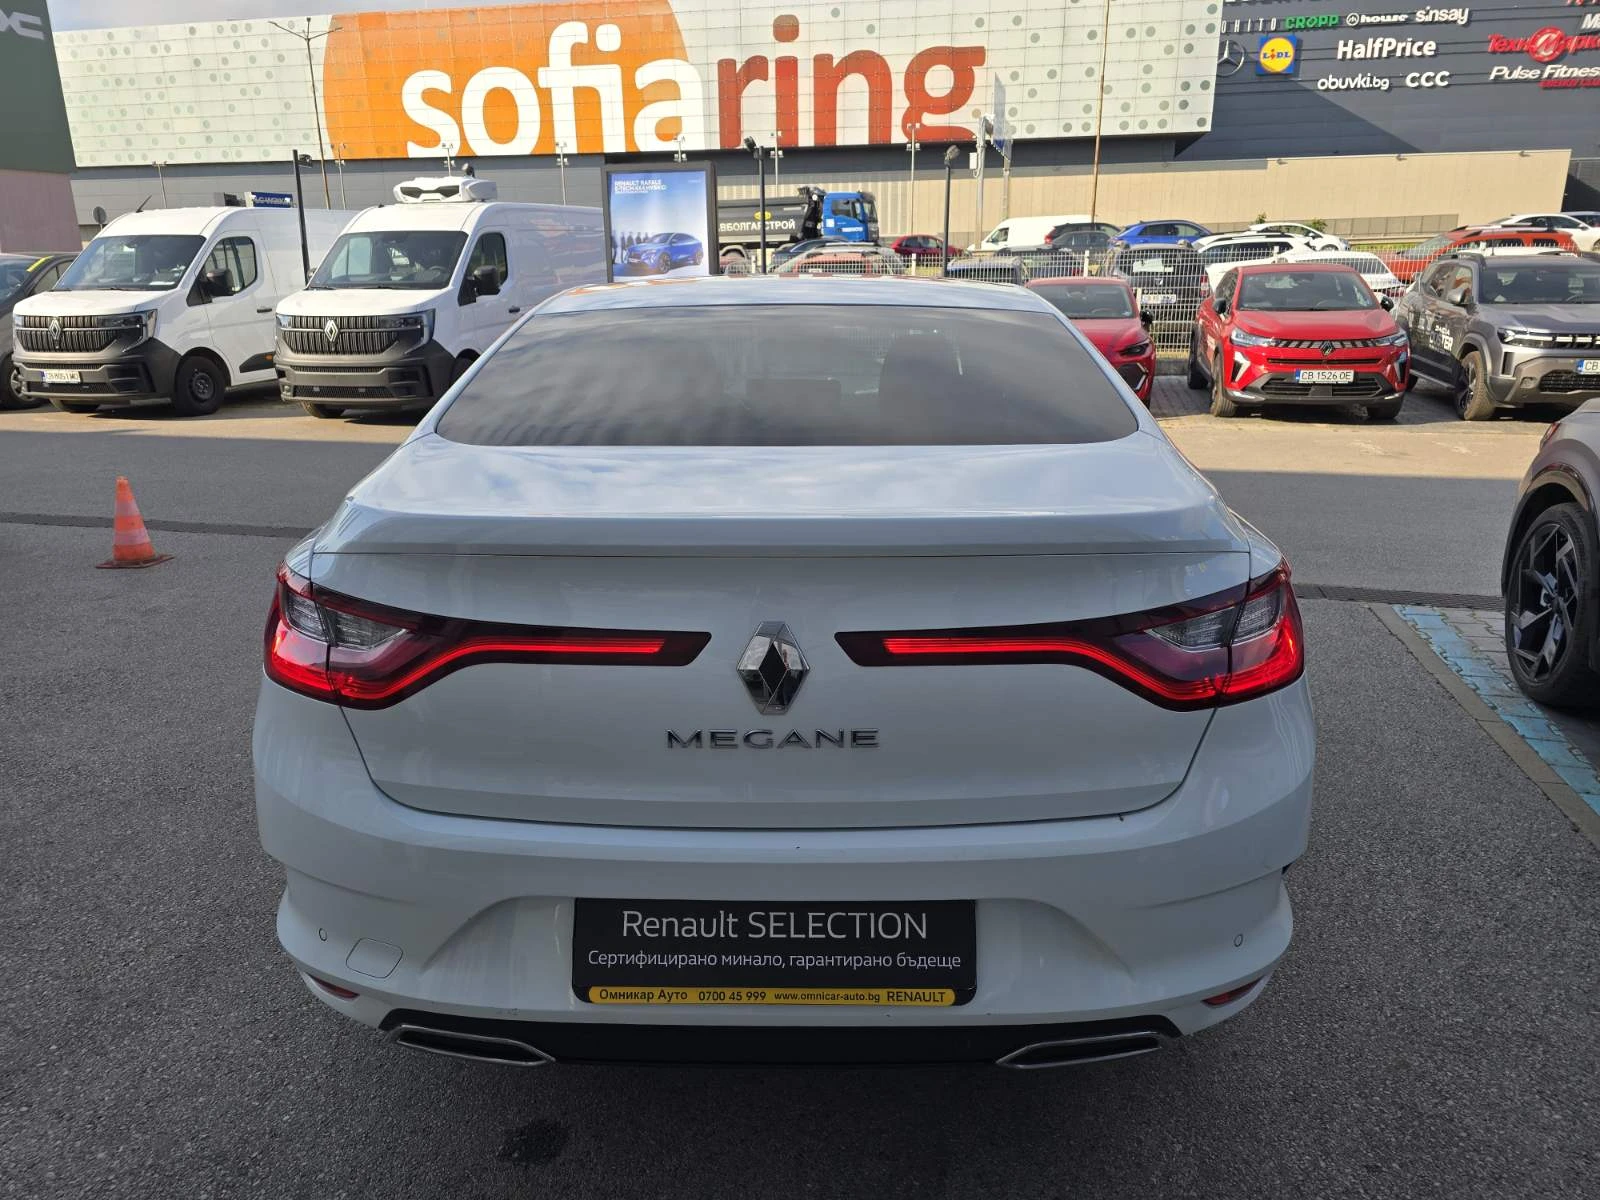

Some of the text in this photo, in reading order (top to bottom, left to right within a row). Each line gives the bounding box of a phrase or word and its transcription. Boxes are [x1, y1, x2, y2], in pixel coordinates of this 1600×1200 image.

[1285, 14, 1340, 29] CROPP
[1415, 6, 1469, 25] sinsay
[1337, 37, 1437, 60] HalfPrice
[1405, 70, 1450, 88] CCC
[1489, 65, 1541, 80] Pulse
[1317, 73, 1390, 90] obuvki.bg
[666, 728, 880, 749] MEGANE
[621, 910, 927, 940] Renault SELECTION
[588, 950, 961, 971] Сертифицирано минало, гарантирано бъдеще
[600, 988, 688, 1003] Омникар Ауто
[698, 991, 766, 1001] 0700 45 999
[774, 991, 880, 1003] www.omnicar-auto.bg
[886, 990, 946, 1003] RENAULT
